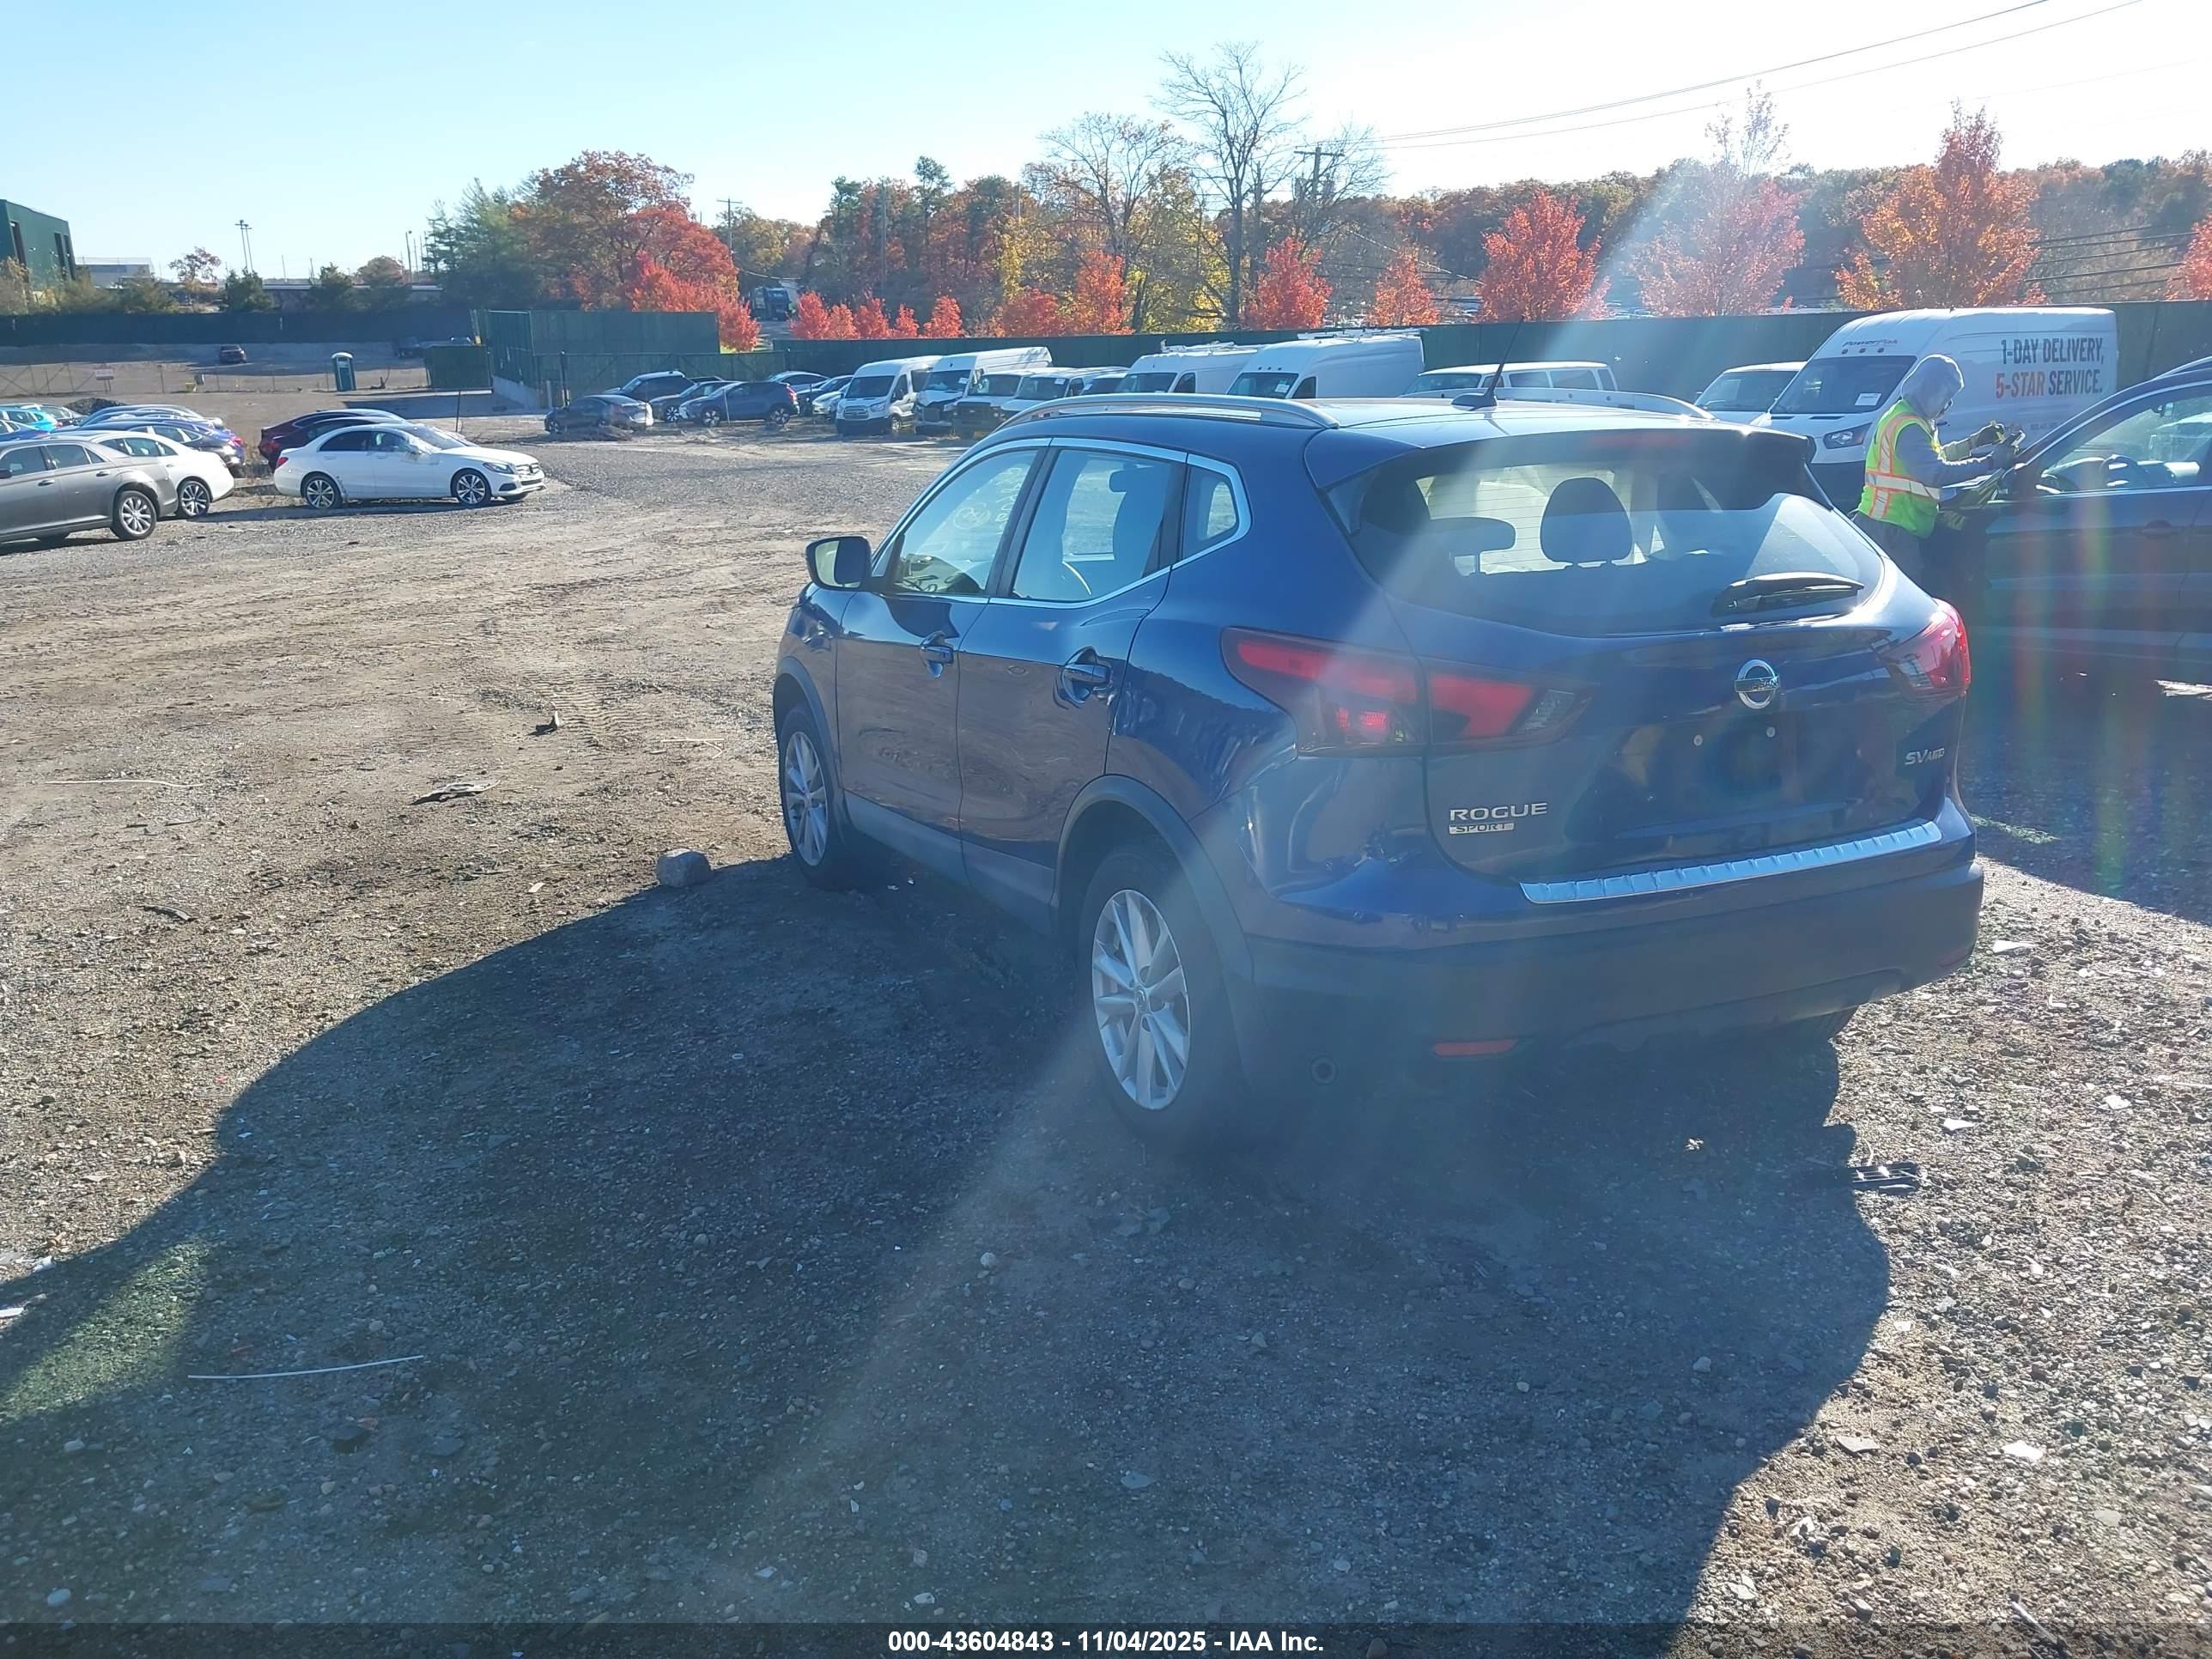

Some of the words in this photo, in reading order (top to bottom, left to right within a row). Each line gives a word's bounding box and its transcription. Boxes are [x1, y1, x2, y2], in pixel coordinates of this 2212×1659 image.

[2001, 338, 2039, 364] 1-DAY
[2042, 337, 2104, 364] DELIVERY,
[1996, 371, 2045, 398] 5-STAR
[2048, 369, 2103, 395] SERVICE.
[1736, 677, 1778, 690] SSAN
[1449, 802, 1548, 821] ROGUE
[1455, 823, 1507, 833] SPORT
